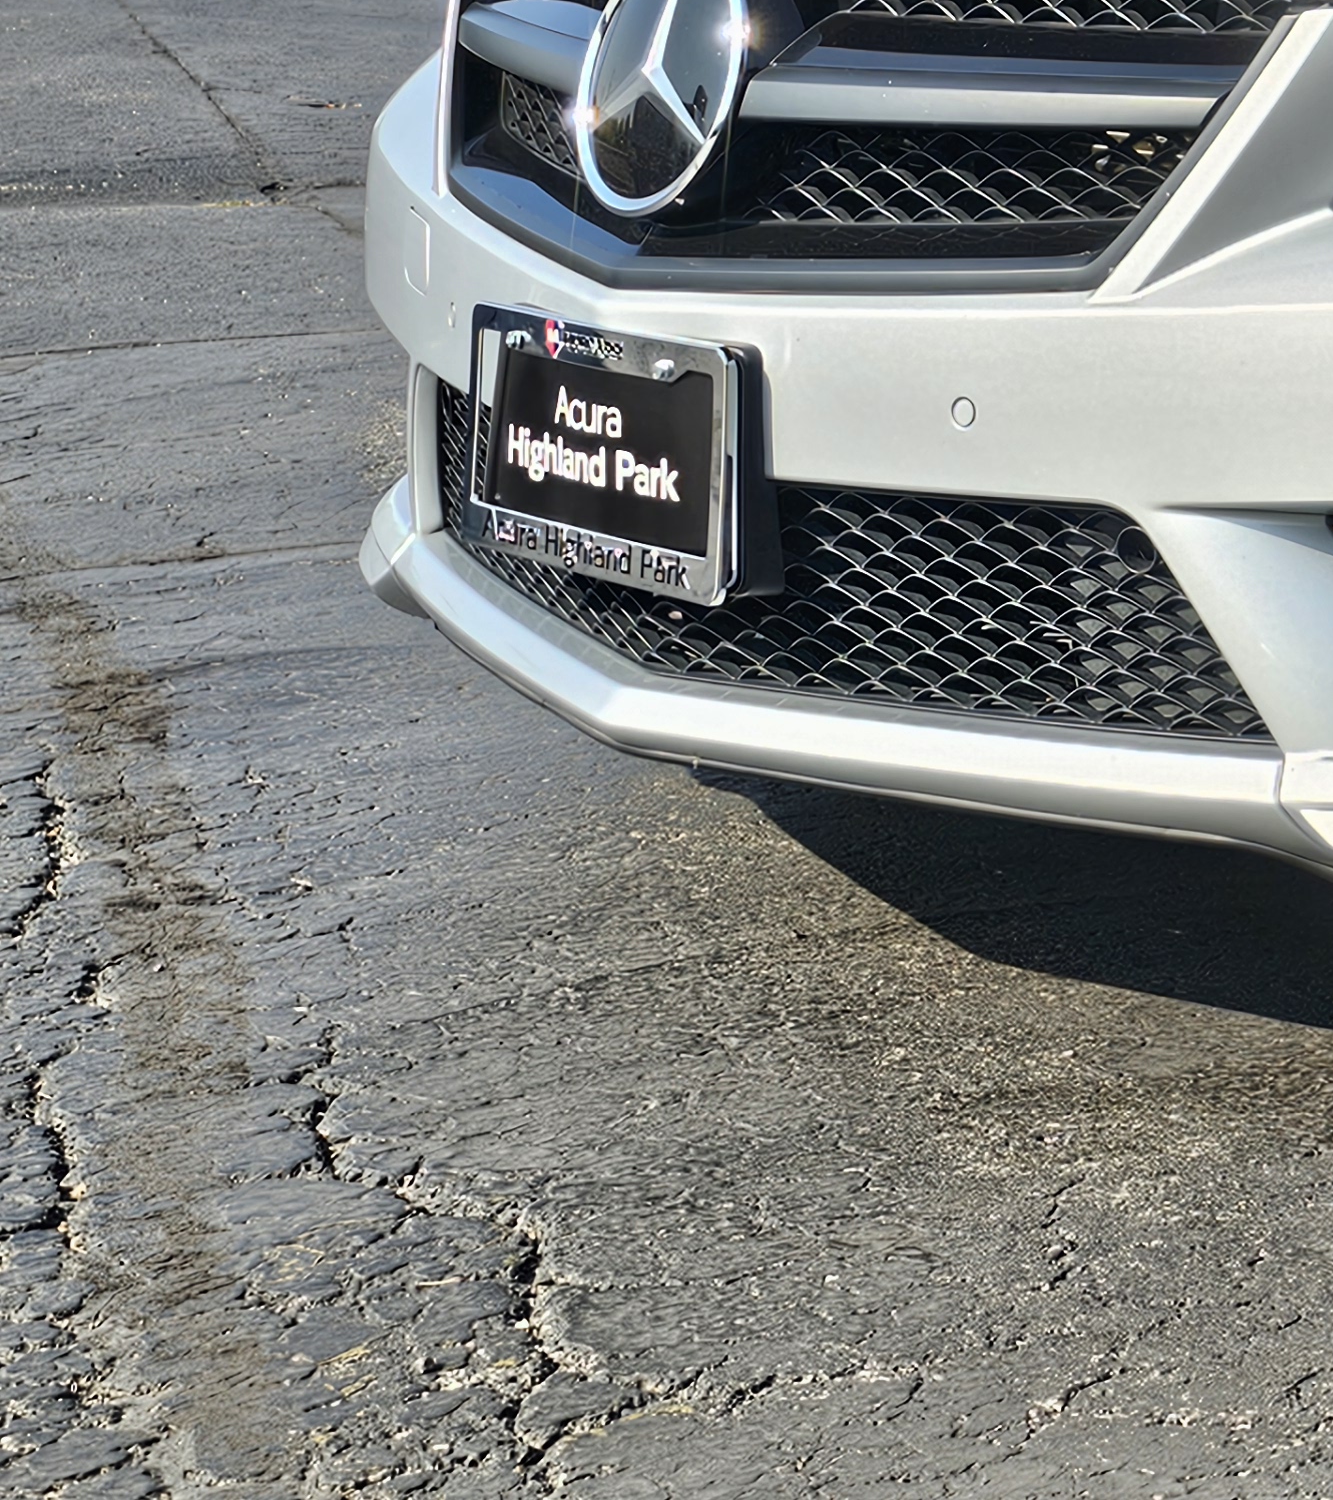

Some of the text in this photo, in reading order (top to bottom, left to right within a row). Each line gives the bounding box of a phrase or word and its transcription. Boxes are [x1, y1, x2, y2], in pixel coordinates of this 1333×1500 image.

[553, 385, 622, 438] Acura
[507, 423, 681, 502] Highland Park
[482, 509, 691, 590] Acura Highland Park
